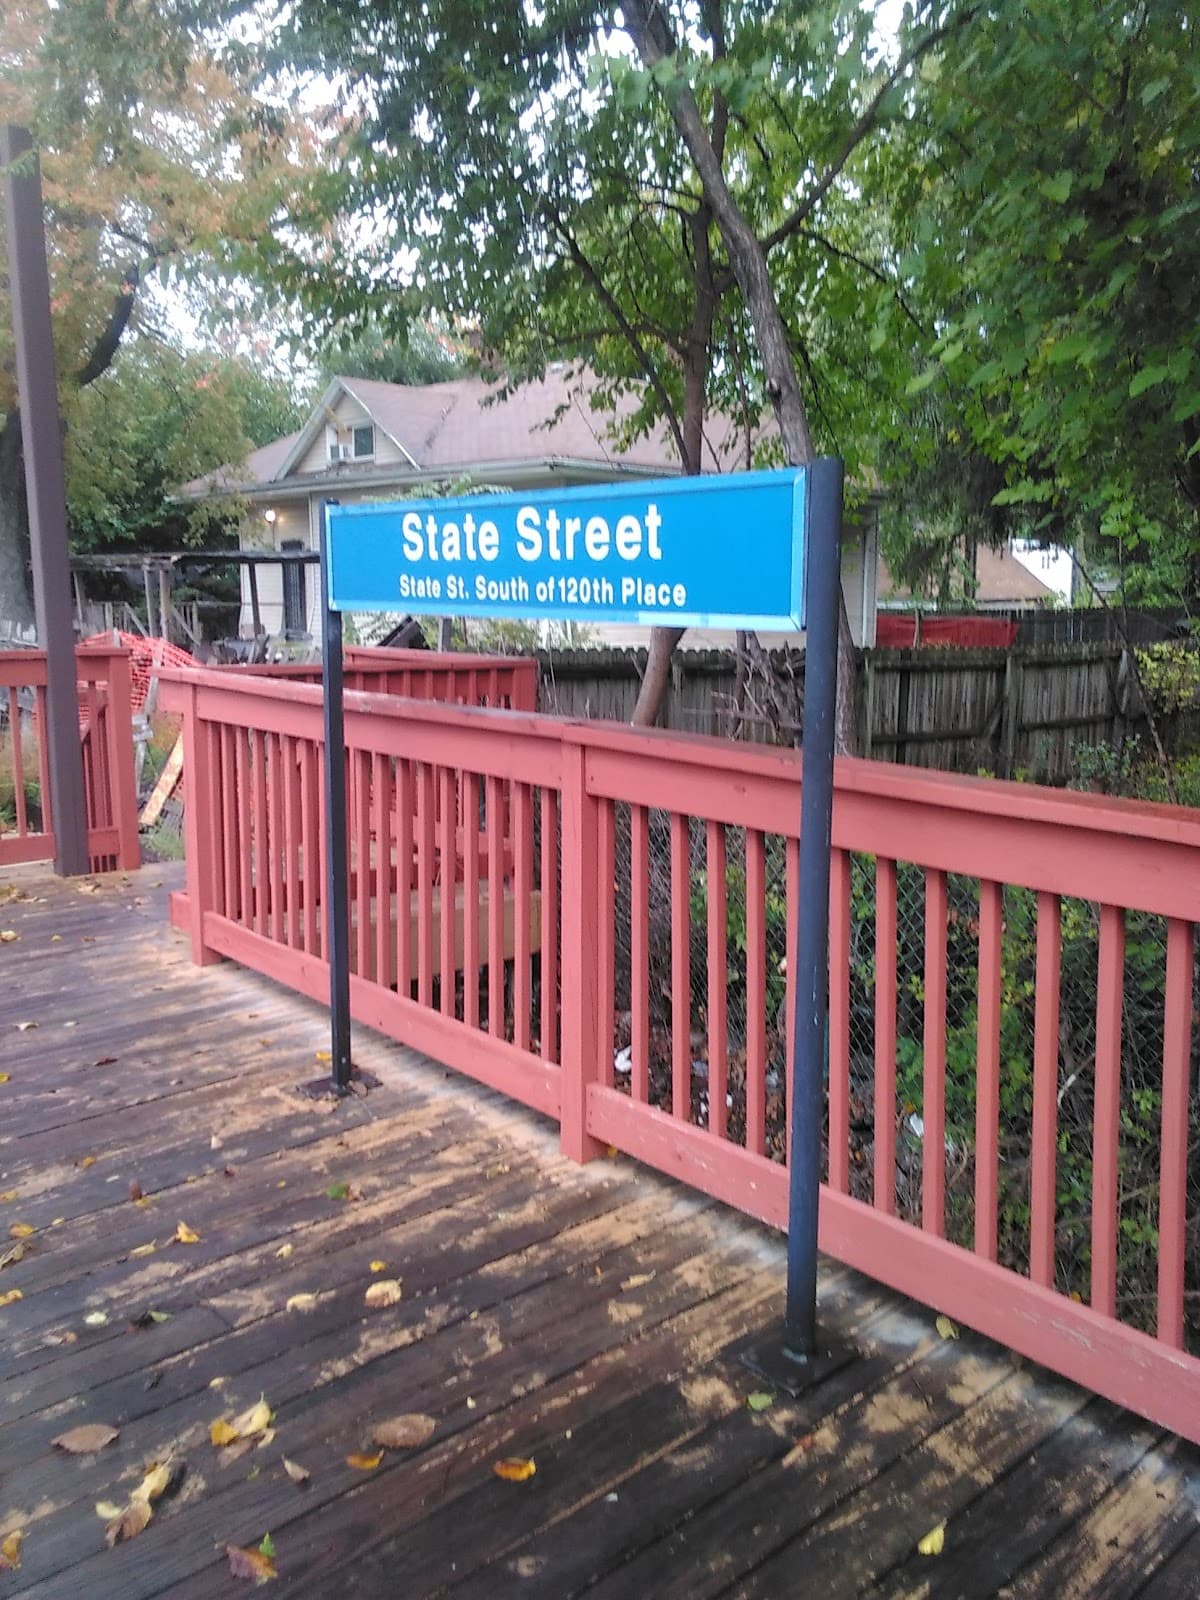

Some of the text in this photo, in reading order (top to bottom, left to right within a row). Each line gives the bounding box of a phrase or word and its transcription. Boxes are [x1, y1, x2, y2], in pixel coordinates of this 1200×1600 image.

[402, 503, 662, 562] State Street
[400, 573, 687, 607] State St. South of 120th Place
